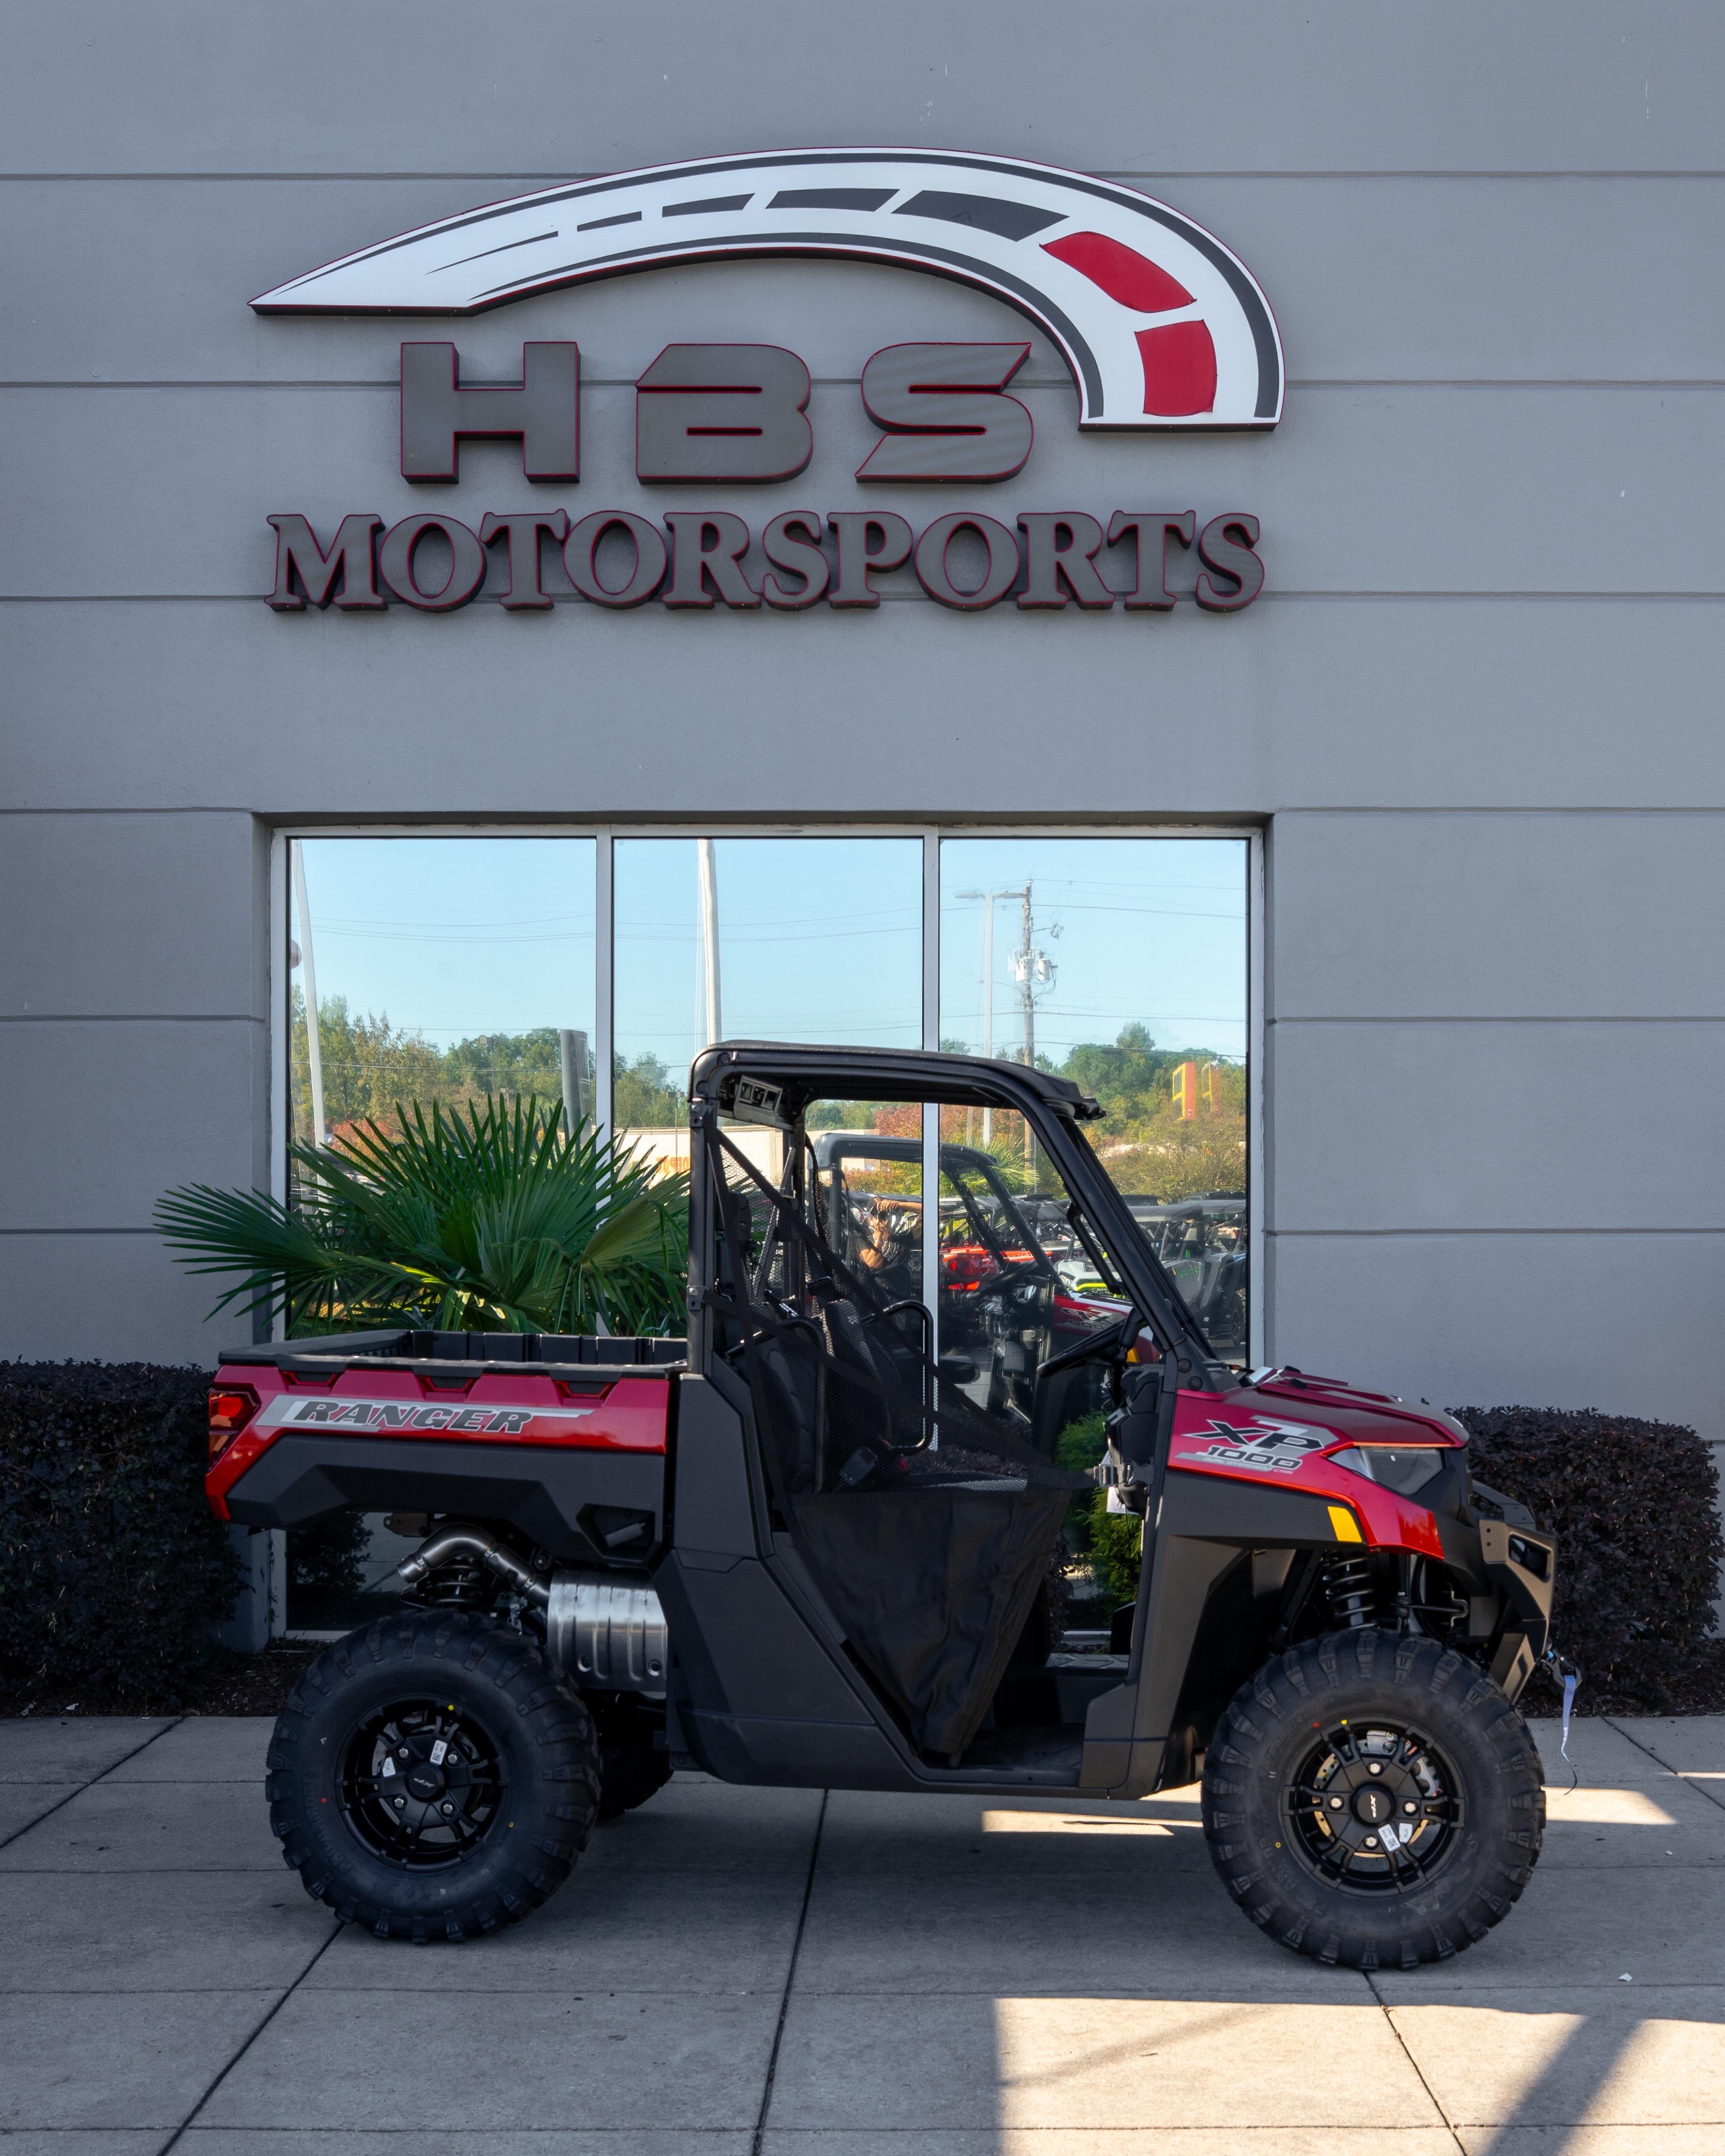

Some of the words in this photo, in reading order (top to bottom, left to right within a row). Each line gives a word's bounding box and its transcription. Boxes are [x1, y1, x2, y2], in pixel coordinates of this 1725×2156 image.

[401, 342, 1034, 484] HBS
[264, 509, 1265, 612] MOTORSPORTS
[292, 1400, 533, 1434] RANGER
[1181, 1419, 1324, 1450] XP
[1208, 1445, 1303, 1470] 1000
